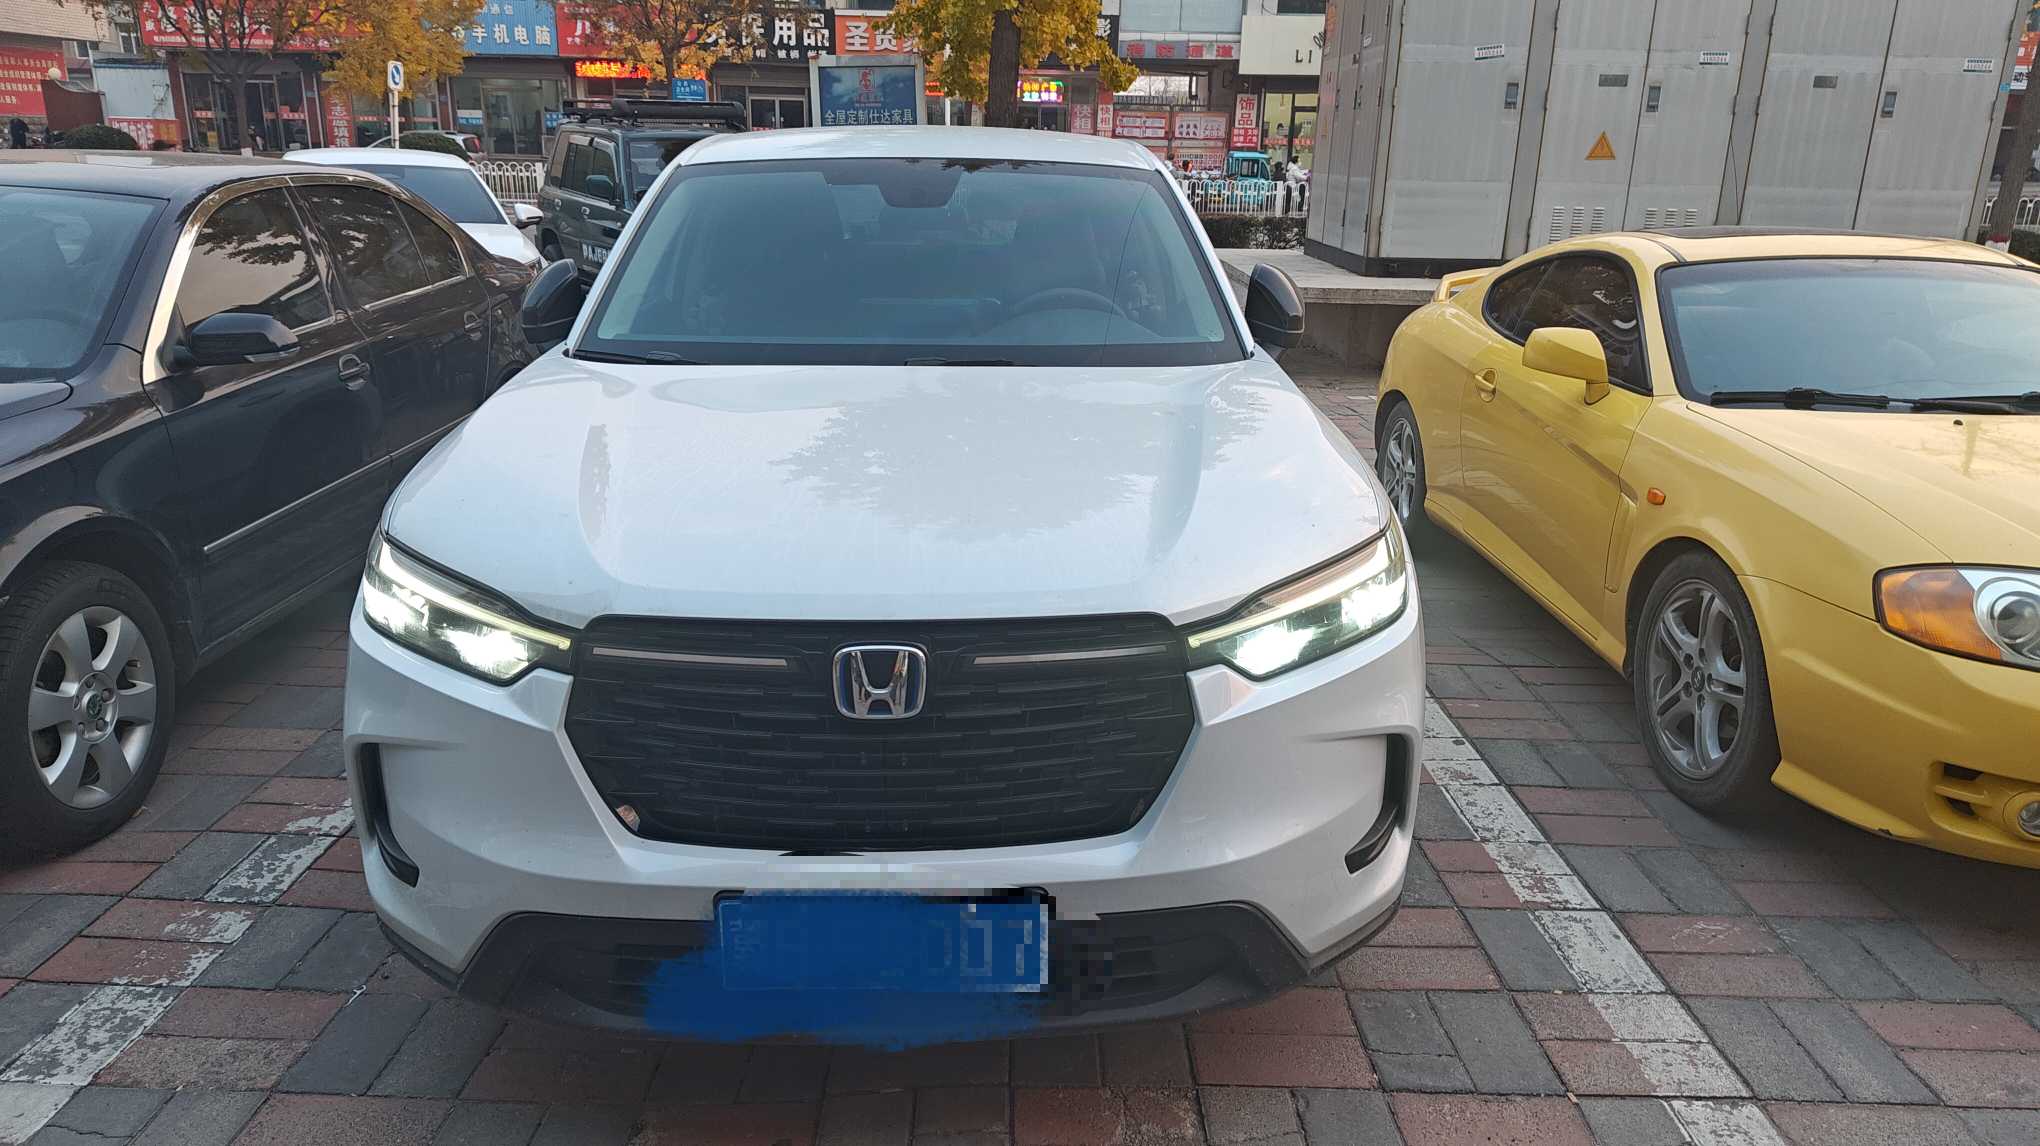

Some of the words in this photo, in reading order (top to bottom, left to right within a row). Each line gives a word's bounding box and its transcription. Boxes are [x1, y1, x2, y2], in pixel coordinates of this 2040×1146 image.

[1127, 41, 1233, 59] 消防通道
[824, 109, 914, 126] 全屋定制仕达家具
[1238, 96, 1256, 127] 饰品
[581, 243, 610, 265] PAJER
